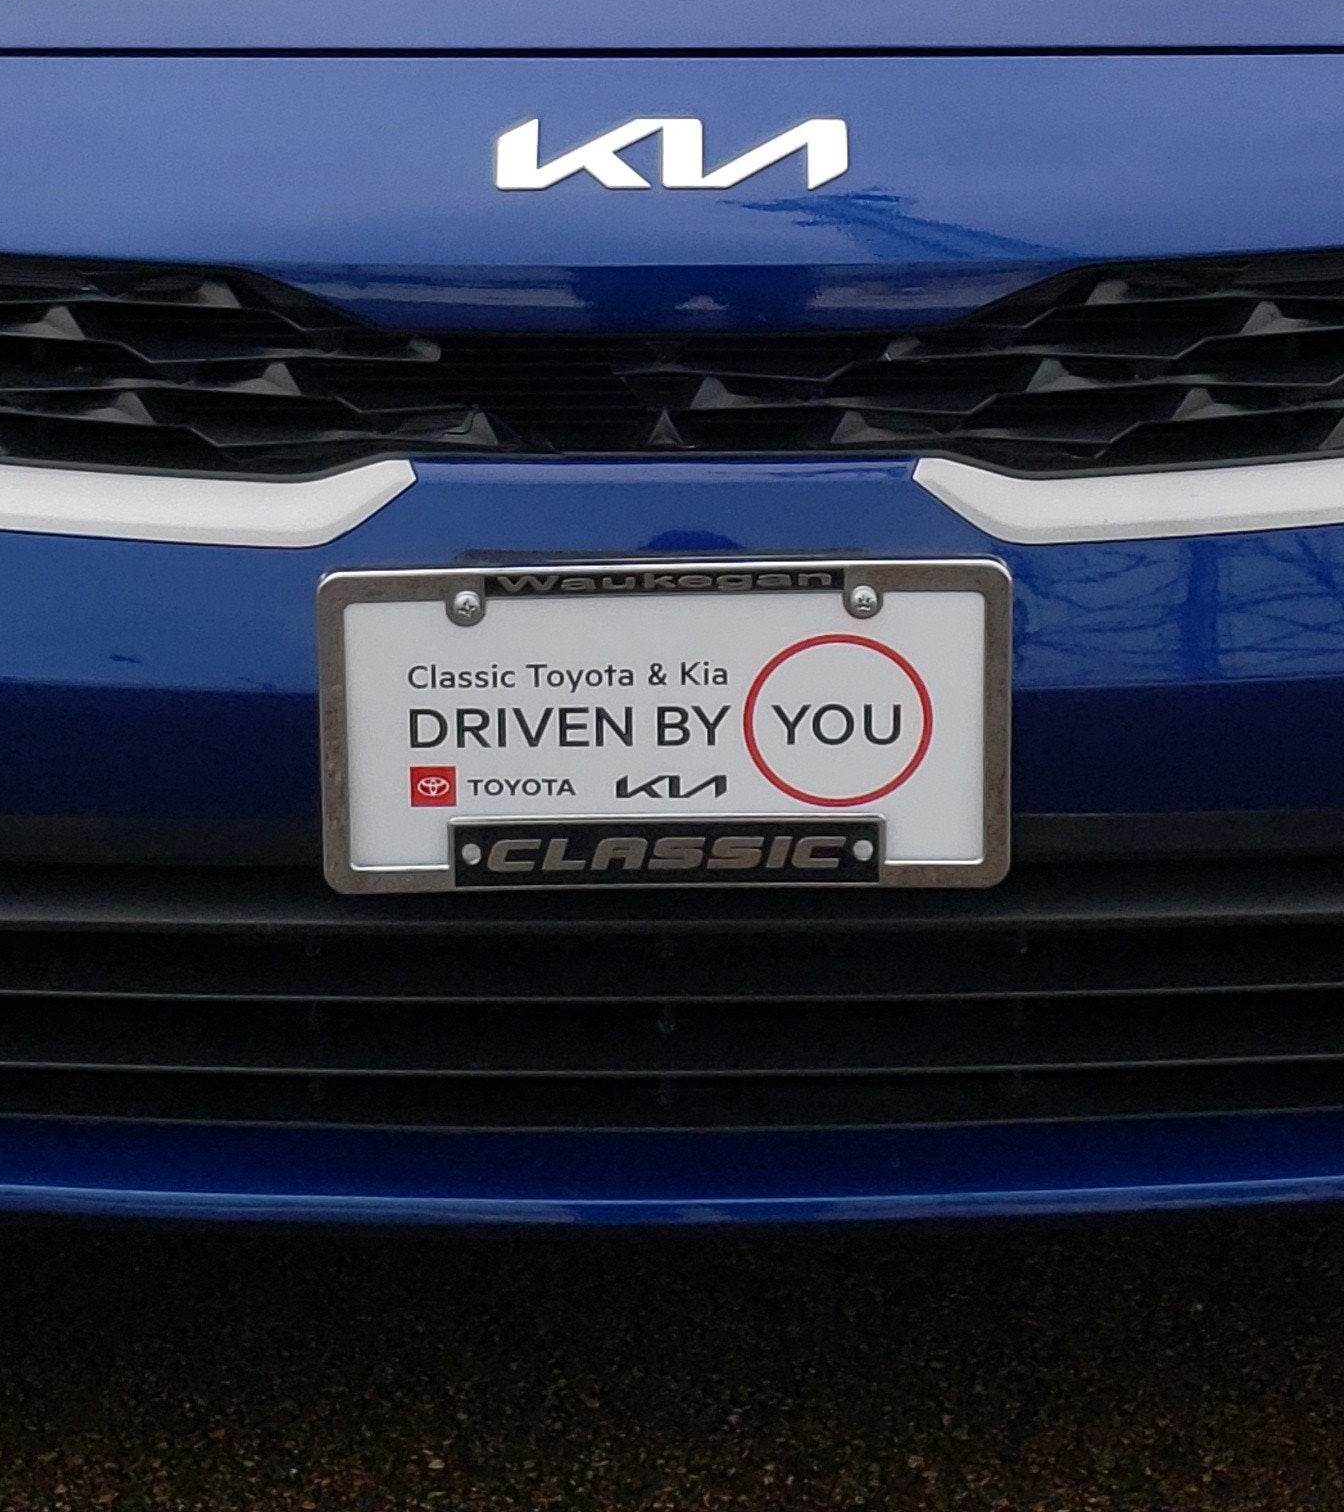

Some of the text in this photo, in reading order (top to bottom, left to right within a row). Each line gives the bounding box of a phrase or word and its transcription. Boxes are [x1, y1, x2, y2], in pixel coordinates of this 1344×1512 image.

[496, 117, 849, 190] KIA
[495, 571, 832, 592] Waukegan
[407, 661, 729, 691] Classic Toyota & Kia
[409, 704, 902, 749] DRIVEN BY YOU
[467, 774, 727, 799] TOYOTA KIA
[486, 835, 846, 872] CLASSIC
